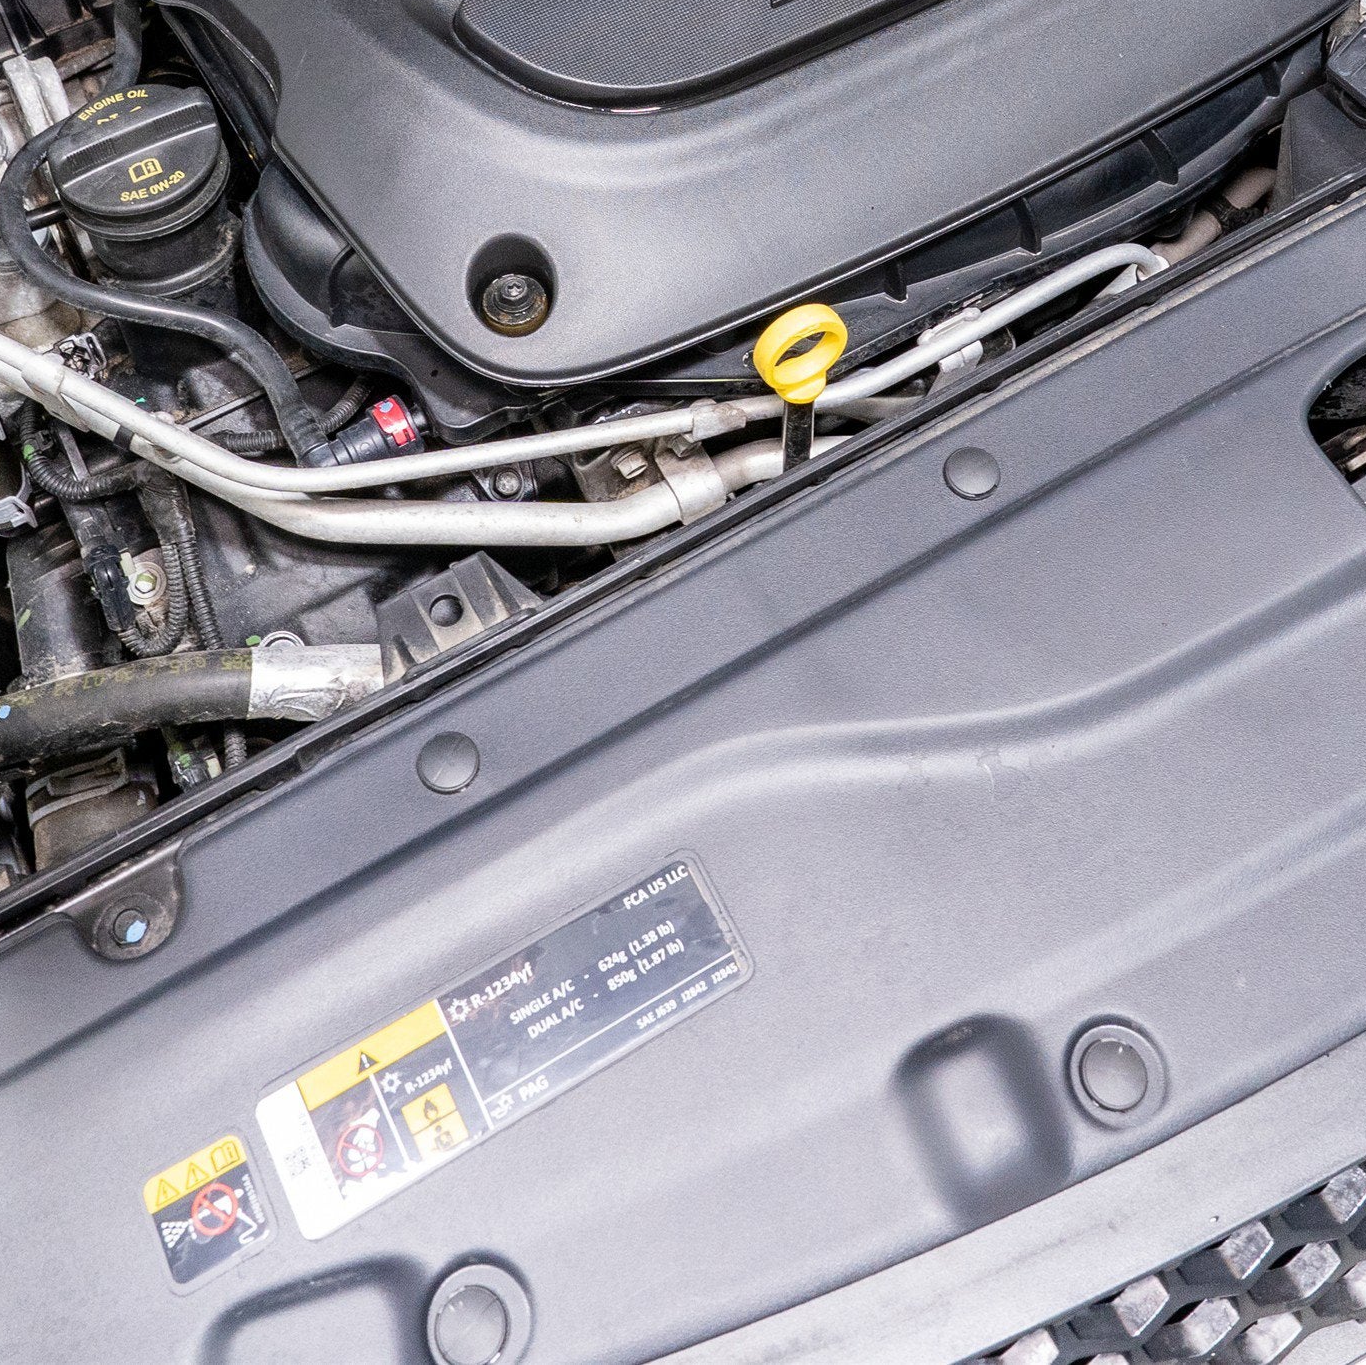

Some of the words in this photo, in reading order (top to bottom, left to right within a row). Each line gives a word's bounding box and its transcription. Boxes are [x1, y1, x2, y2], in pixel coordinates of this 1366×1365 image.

[78, 93, 125, 121] ENGINE
[126, 89, 149, 99] OIL
[120, 188, 149, 202] SAE
[149, 170, 186, 195] 0W-20
[623, 888, 649, 910] FCA
[647, 877, 667, 895] US
[665, 865, 688, 885] LLC
[470, 961, 533, 1009] R-1234yf
[510, 992, 552, 1025] SINGLE
[552, 979, 575, 1001] A/C
[598, 950, 629, 972] 624g
[628, 929, 658, 956] (1.38
[656, 920, 675, 938] lb)
[527, 1013, 562, 1039] DUAL
[561, 998, 585, 1019] A/C
[607, 968, 638, 991] 850g
[636, 948, 666, 974] (1.87
[666, 938, 685, 955] lb)
[636, 1010, 657, 1030] SAE
[655, 999, 678, 1019] J639
[680, 980, 708, 1003] J2842
[710, 962, 738, 984] J2845
[404, 1057, 453, 1095] R-1234yf
[518, 1074, 549, 1102] PAG
